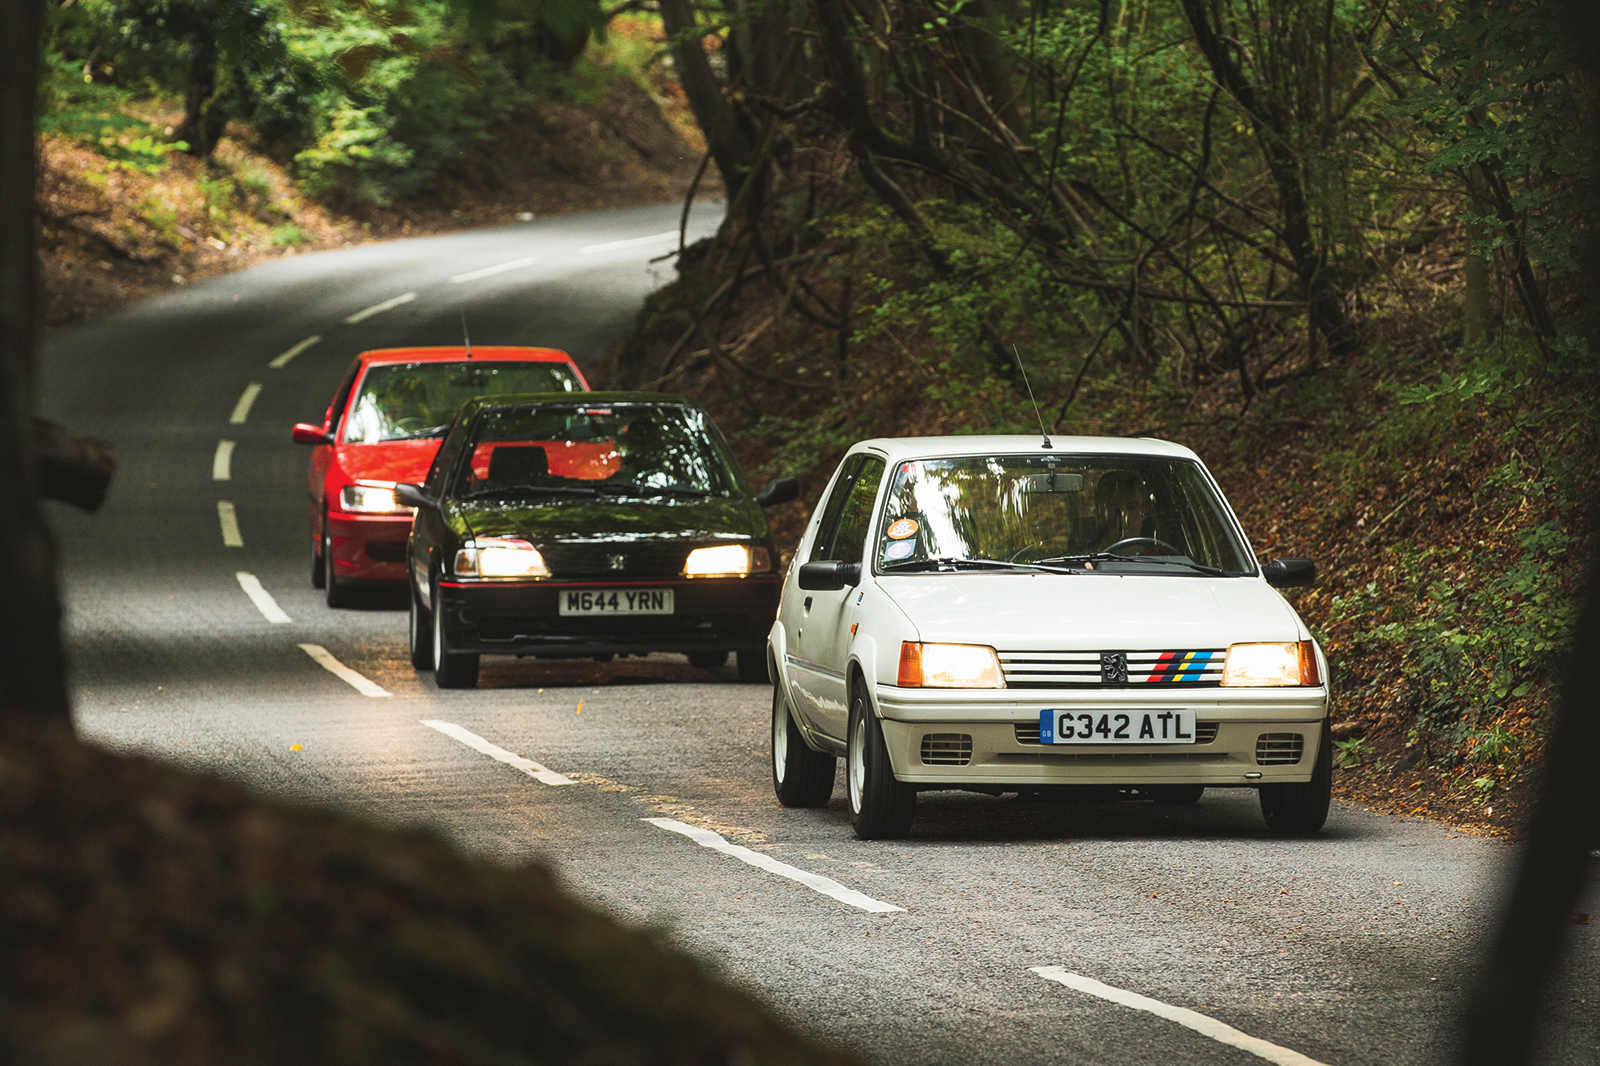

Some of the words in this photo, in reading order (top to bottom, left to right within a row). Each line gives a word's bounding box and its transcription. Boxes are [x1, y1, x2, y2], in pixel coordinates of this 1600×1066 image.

[567, 592, 619, 611] M644
[625, 591, 664, 611] YRN
[1041, 730, 1052, 738] GB
[1058, 713, 1130, 739] G342
[1139, 712, 1192, 739] ATL
